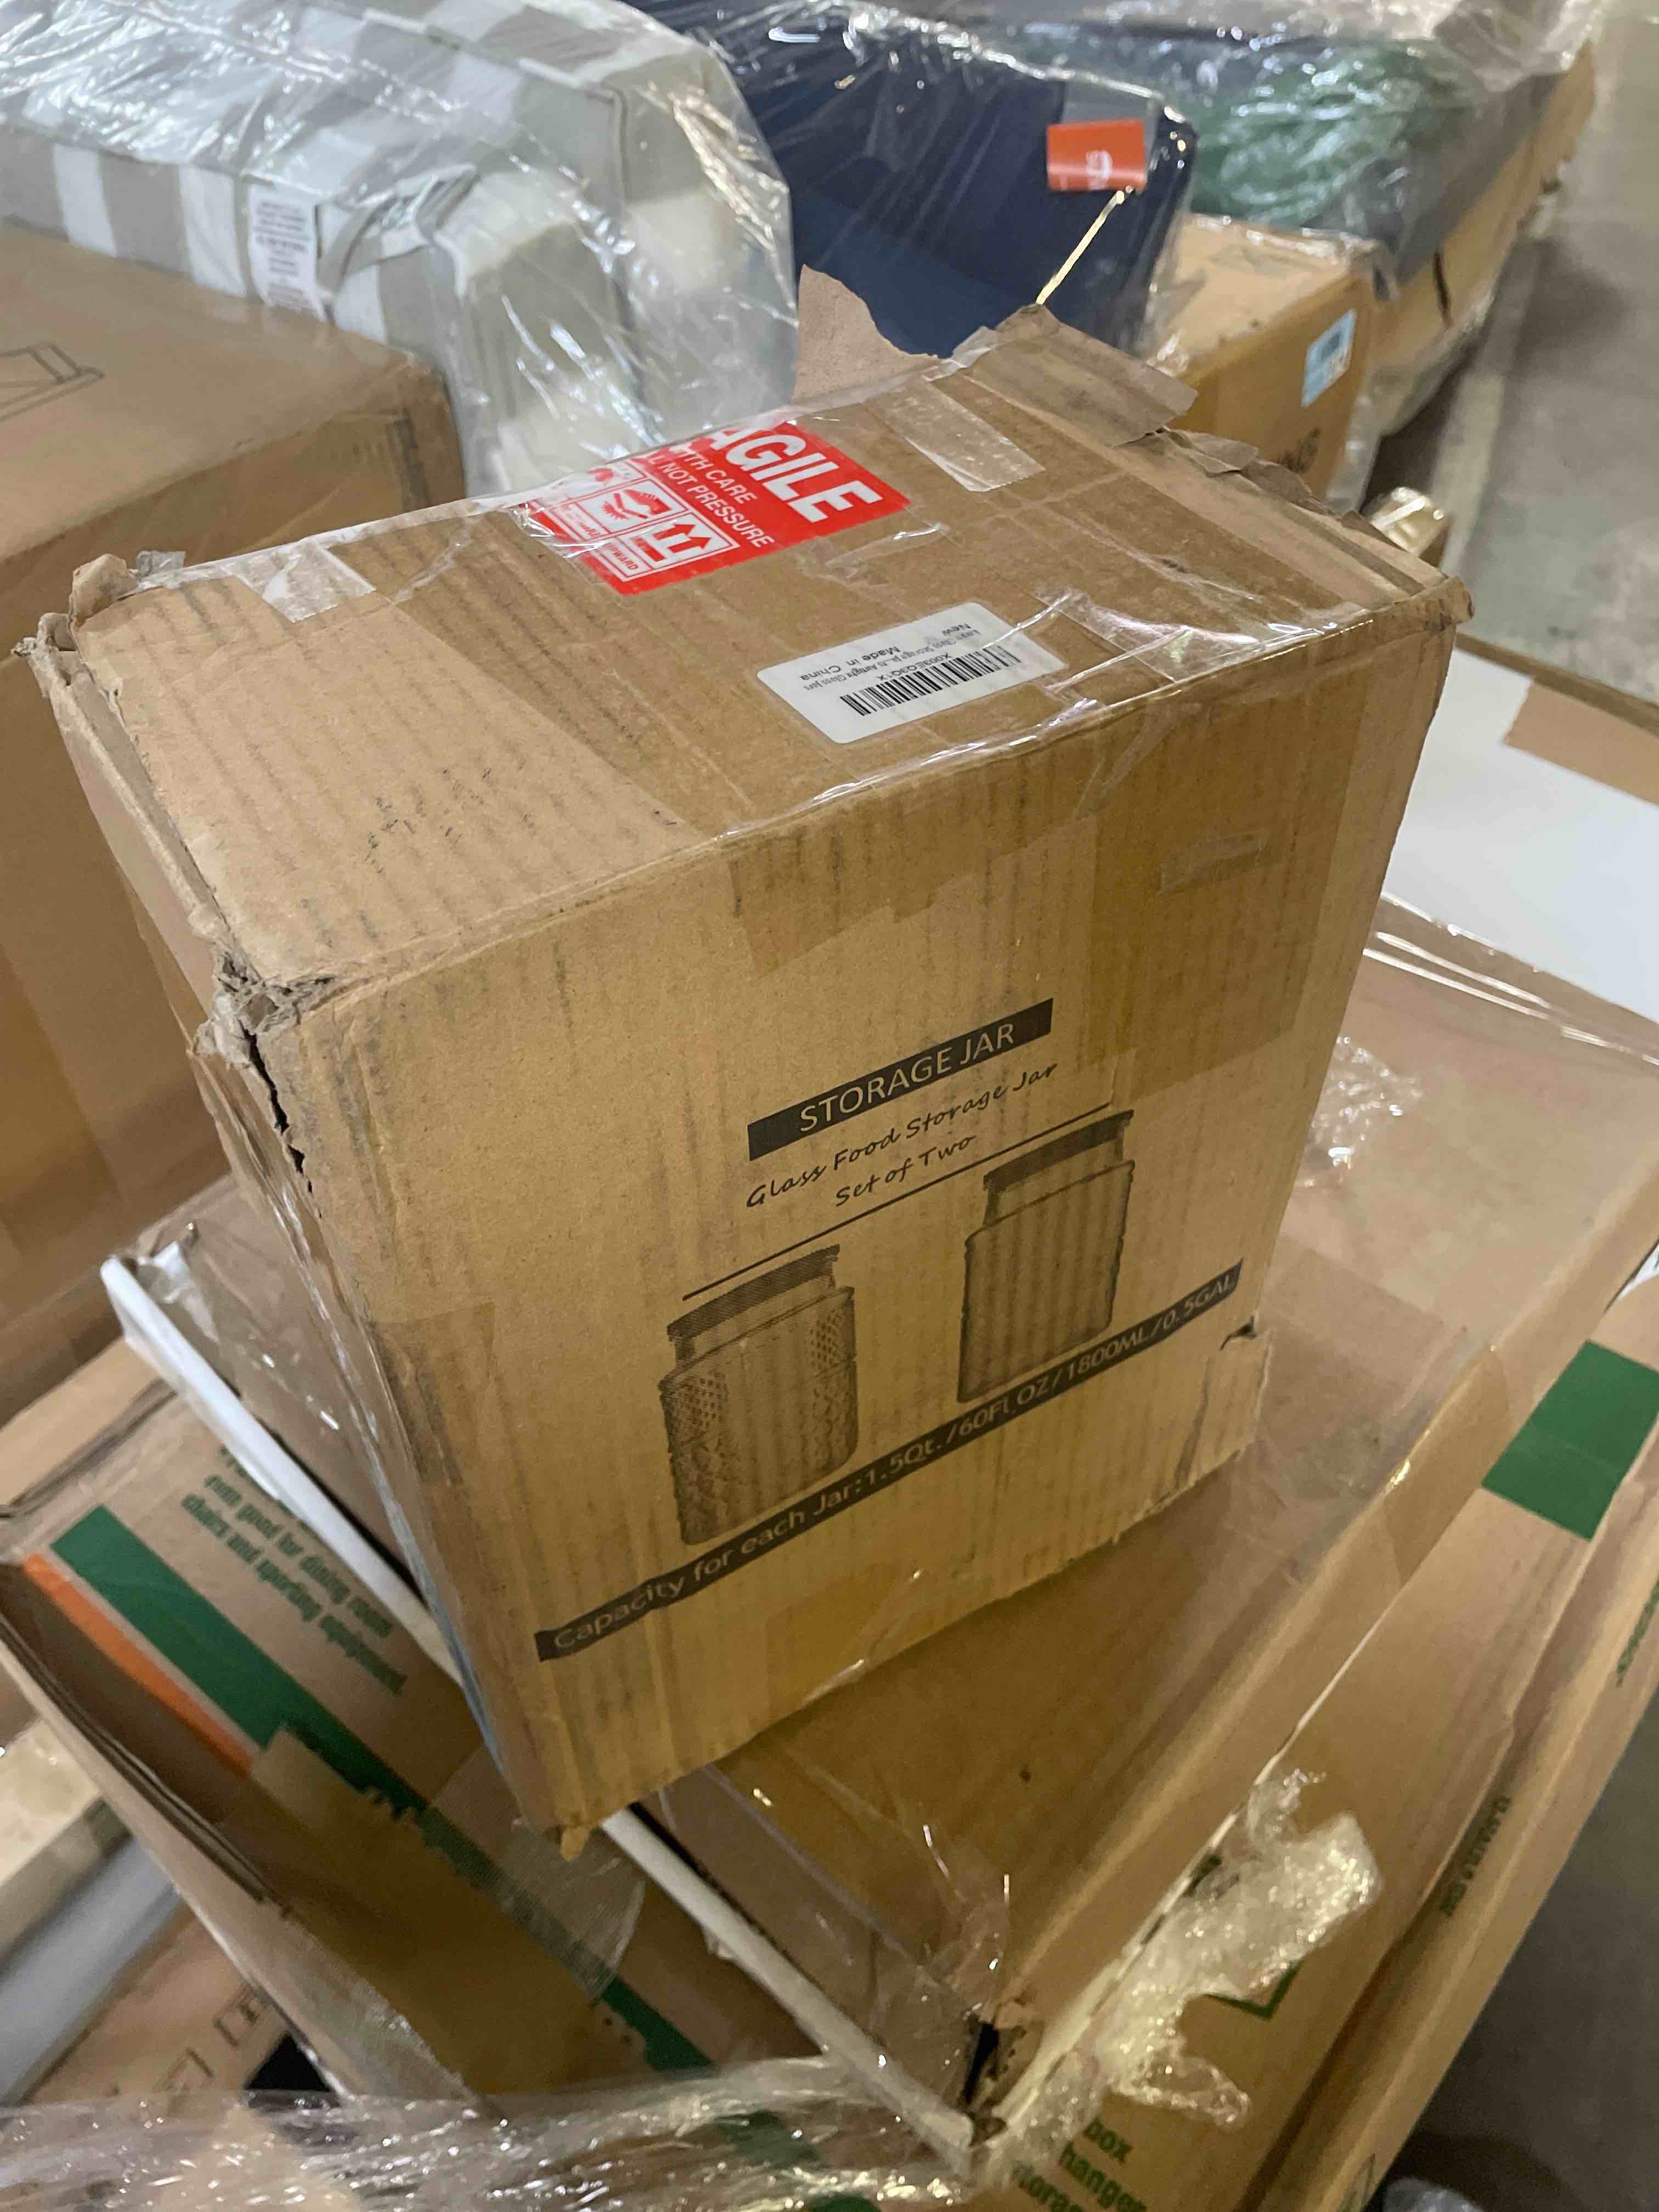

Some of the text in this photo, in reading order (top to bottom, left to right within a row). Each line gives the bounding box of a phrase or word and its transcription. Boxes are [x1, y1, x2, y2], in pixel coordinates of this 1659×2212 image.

[658, 462, 697, 484] NOT
[687, 479, 775, 548] PRESSURE
[706, 470, 758, 504] CARE
[861, 646, 901, 661] Made
[941, 623, 970, 636] New
[800, 665, 842, 681] China
[799, 1023, 1014, 1132] STORAGE JAR
[746, 1063, 1058, 1207] Glass Food Storage Jar
[835, 1135, 977, 1207] Set of Two
[553, 1576, 685, 1648] Capacity
[695, 1548, 733, 1582] for
[741, 1509, 805, 1555] each
[1082, 2116, 1132, 2162] box
